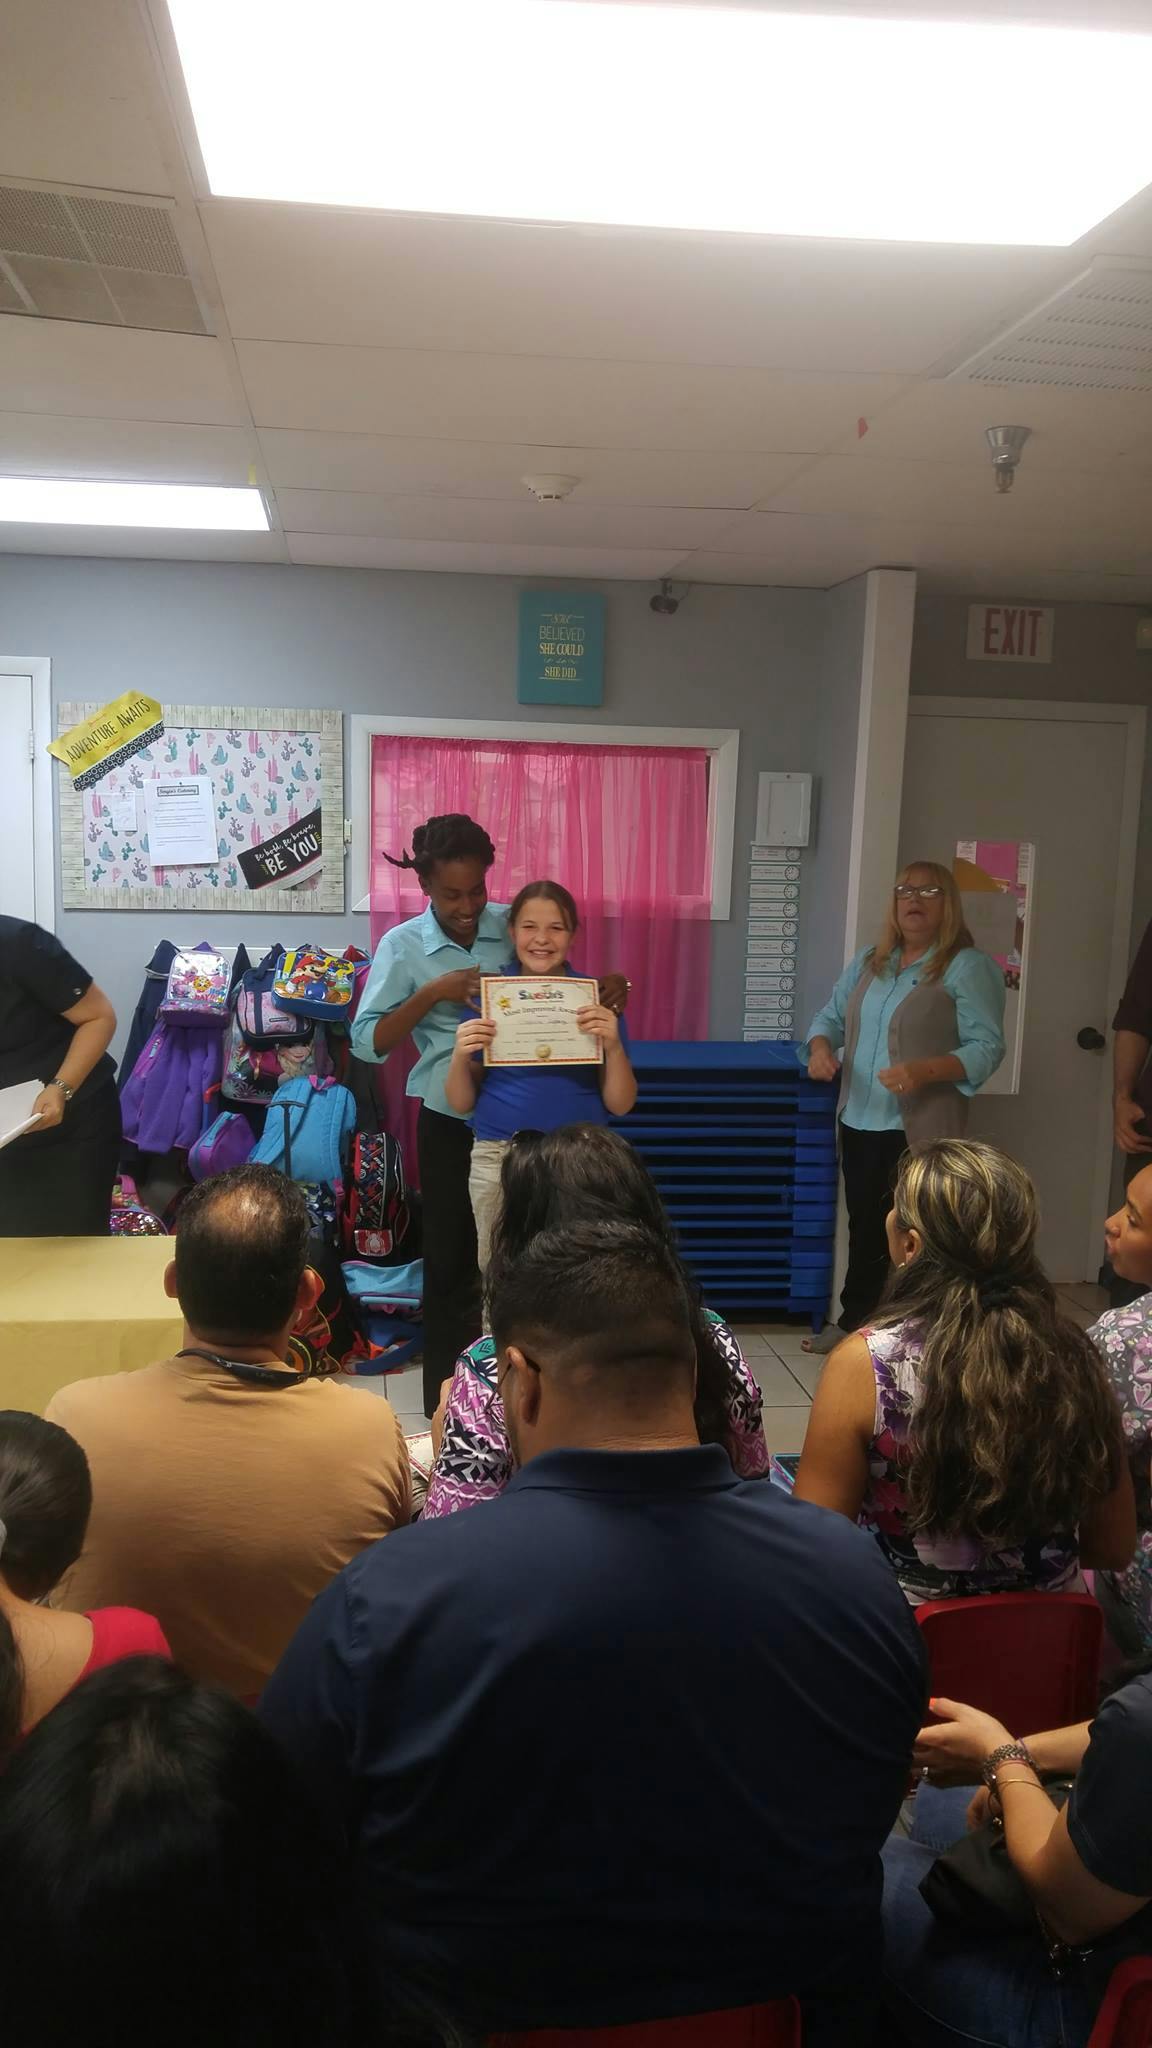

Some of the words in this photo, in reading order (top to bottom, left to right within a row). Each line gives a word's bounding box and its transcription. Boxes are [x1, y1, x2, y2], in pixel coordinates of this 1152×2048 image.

[539, 625, 585, 641] BELIEVED
[984, 607, 1043, 656] EXIT
[539, 642, 556, 655] SHE
[556, 643, 584, 656] COULD
[544, 666, 561, 678] SHE
[561, 667, 577, 678] DID
[66, 721, 118, 762] ADVENTURE
[116, 698, 151, 729] AWAITS
[264, 852, 287, 876] BE
[287, 833, 318, 862] YOU
